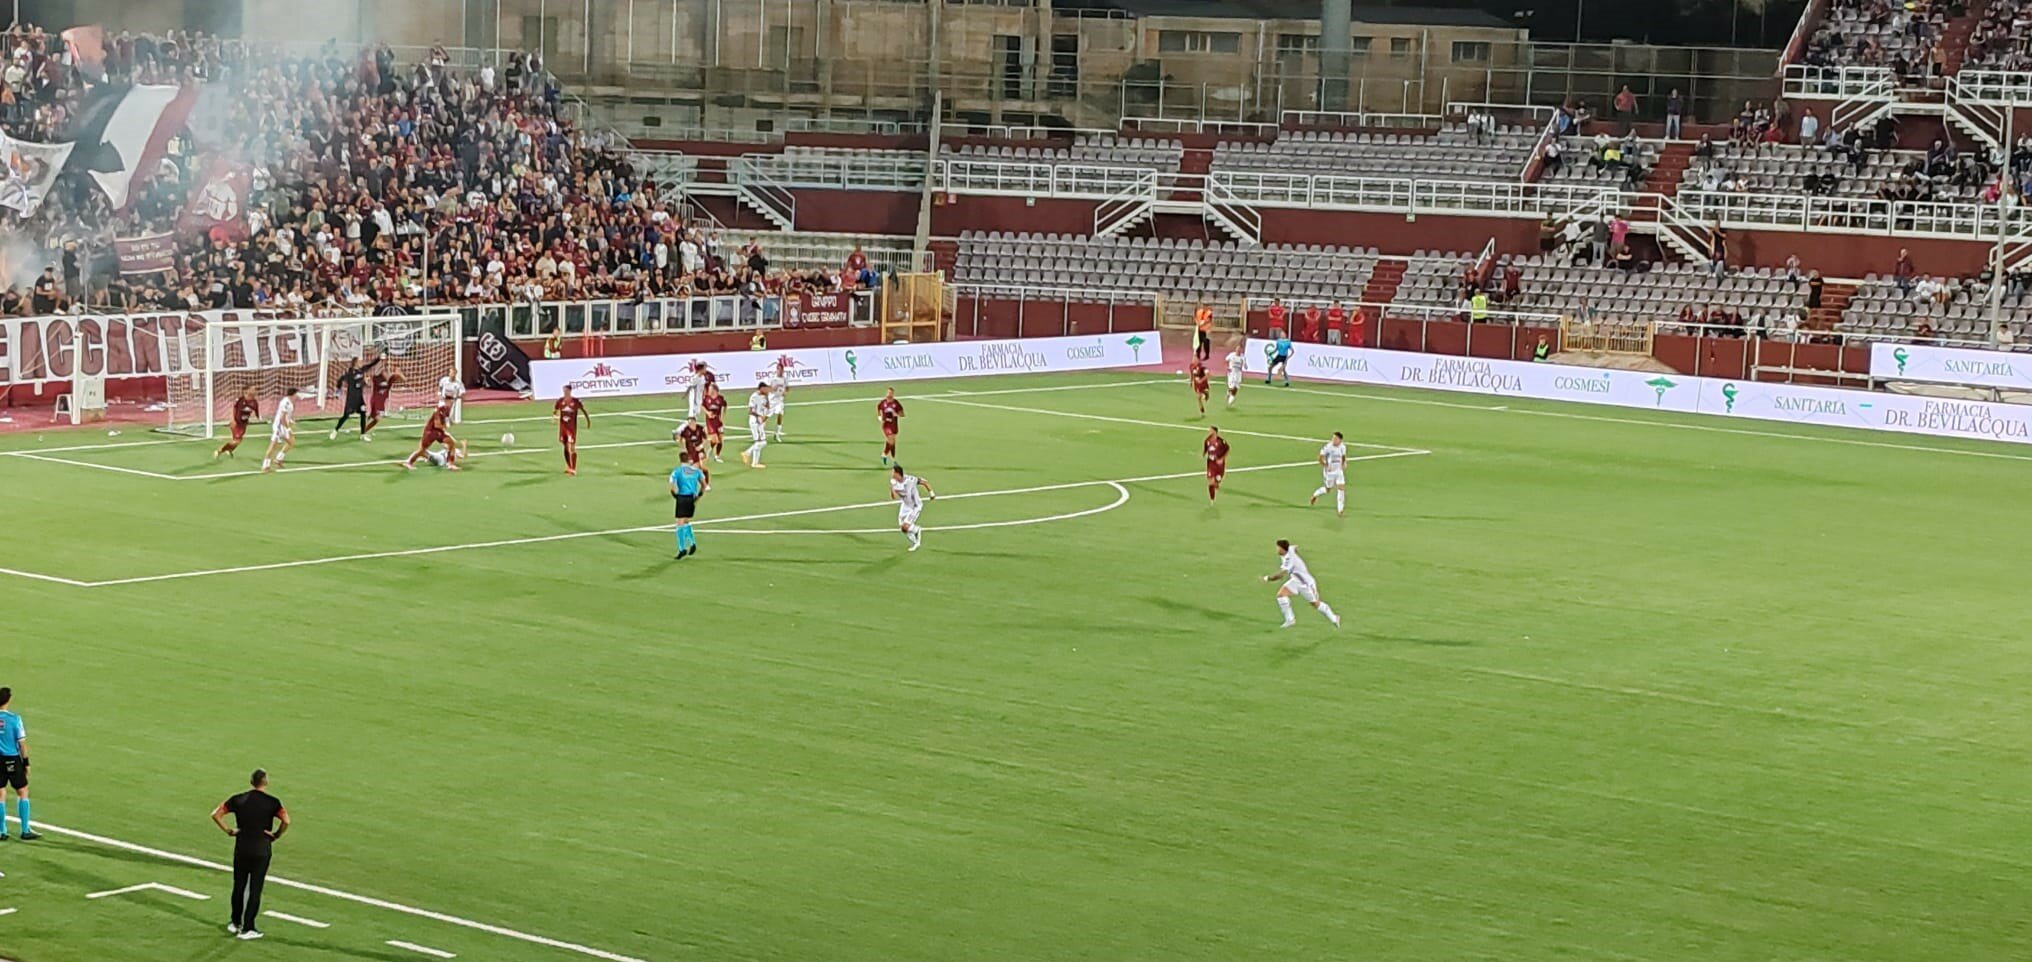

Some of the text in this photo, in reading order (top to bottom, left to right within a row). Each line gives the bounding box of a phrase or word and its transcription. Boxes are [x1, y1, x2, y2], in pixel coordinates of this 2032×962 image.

[981, 342, 1024, 356] FARMACIA
[884, 353, 934, 369] SANITARIA
[959, 352, 1048, 371] DR. BEVILACQUA
[1307, 354, 1369, 372] SANITARIA
[1434, 358, 1492, 375] FARMACIA
[1944, 359, 2014, 377] SANITARIA
[569, 377, 639, 390] SPORTINVEST
[665, 373, 731, 386] SPOREST
[1401, 366, 1523, 392] DR. BEVILACQUA
[1774, 396, 1847, 416] SANITARIA
[1924, 401, 1992, 418] FARMACIA
[1885, 408, 2029, 438] DR. BEVILACQUA
